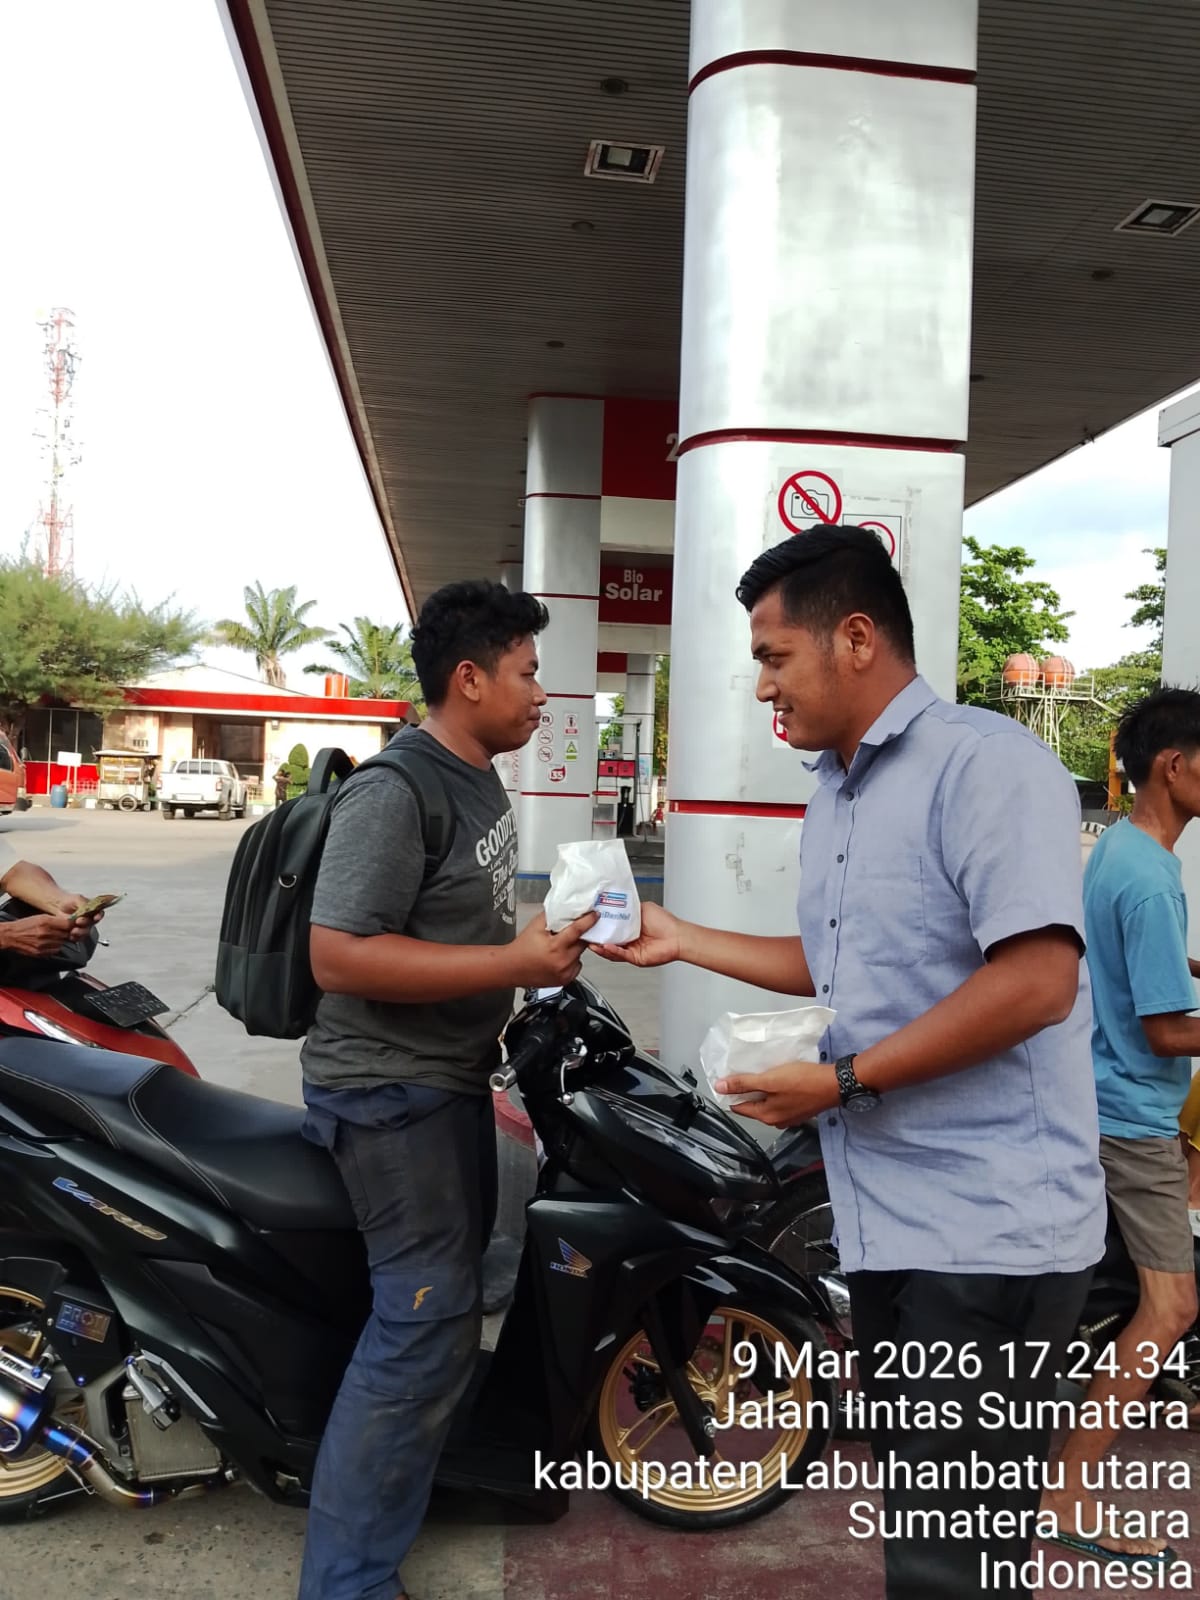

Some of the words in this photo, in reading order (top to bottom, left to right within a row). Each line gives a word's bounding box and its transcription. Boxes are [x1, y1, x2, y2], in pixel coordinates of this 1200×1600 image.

[623, 569, 644, 583] Bio
[604, 582, 663, 602] Solar
[549, 1262, 588, 1279] HONDA
